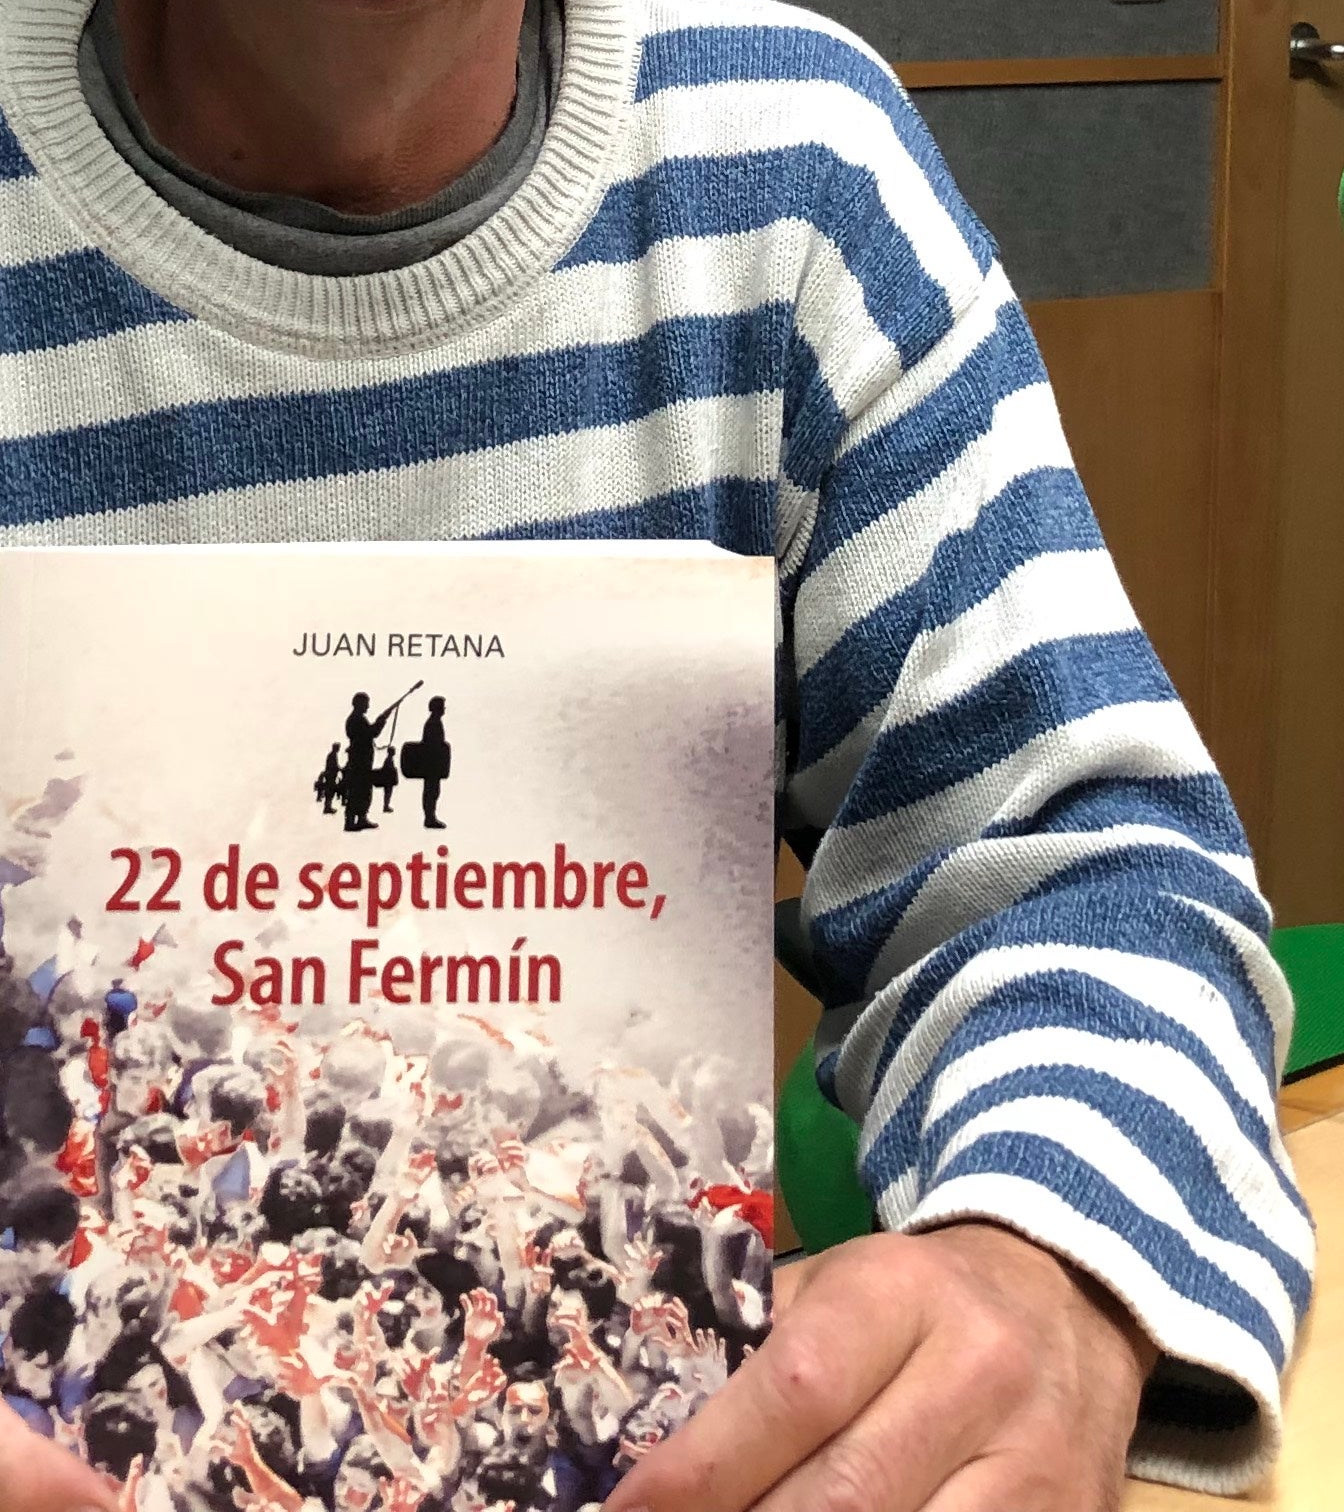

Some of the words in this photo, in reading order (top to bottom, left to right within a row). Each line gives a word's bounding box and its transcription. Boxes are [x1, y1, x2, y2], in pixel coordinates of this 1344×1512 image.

[292, 632, 377, 659] JUAN
[387, 633, 506, 659] RETANA
[105, 846, 183, 912] 22
[202, 843, 278, 912] de
[297, 842, 667, 928] septiembre,
[210, 938, 326, 1006] San
[347, 935, 564, 1005] Fermín
